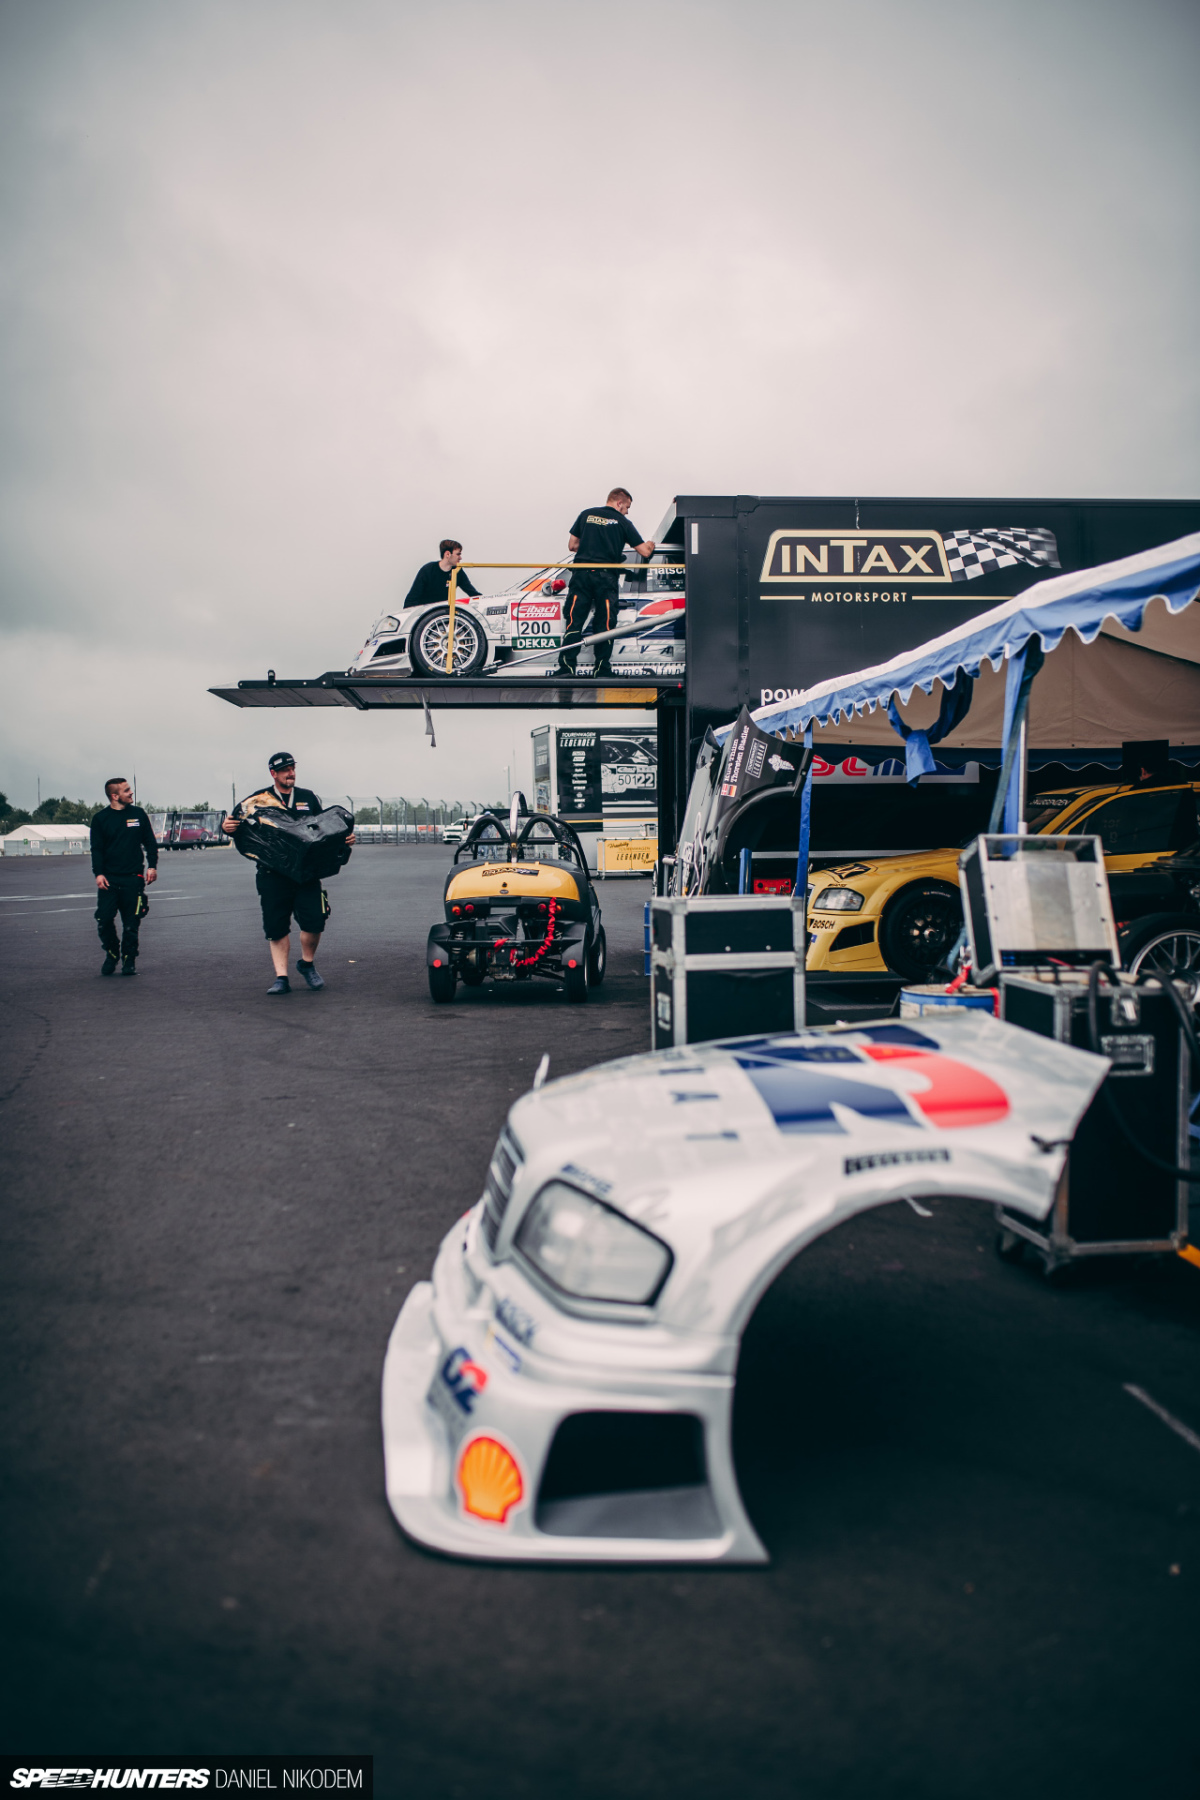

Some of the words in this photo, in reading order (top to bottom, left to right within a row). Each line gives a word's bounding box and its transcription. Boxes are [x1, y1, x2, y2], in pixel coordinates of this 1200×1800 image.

[780, 539, 933, 574] INTAX
[810, 592, 907, 603] MOTORSPORT
[512, 604, 559, 616] Eibach
[520, 621, 551, 635] 200
[516, 638, 557, 649] DEKRA
[560, 739, 596, 748] LEGENDEN
[730, 751, 744, 783] Thorsten
[738, 725, 750, 751] Stadler
[616, 852, 650, 861] LEGENDEN
[812, 919, 836, 930] BOSCH
